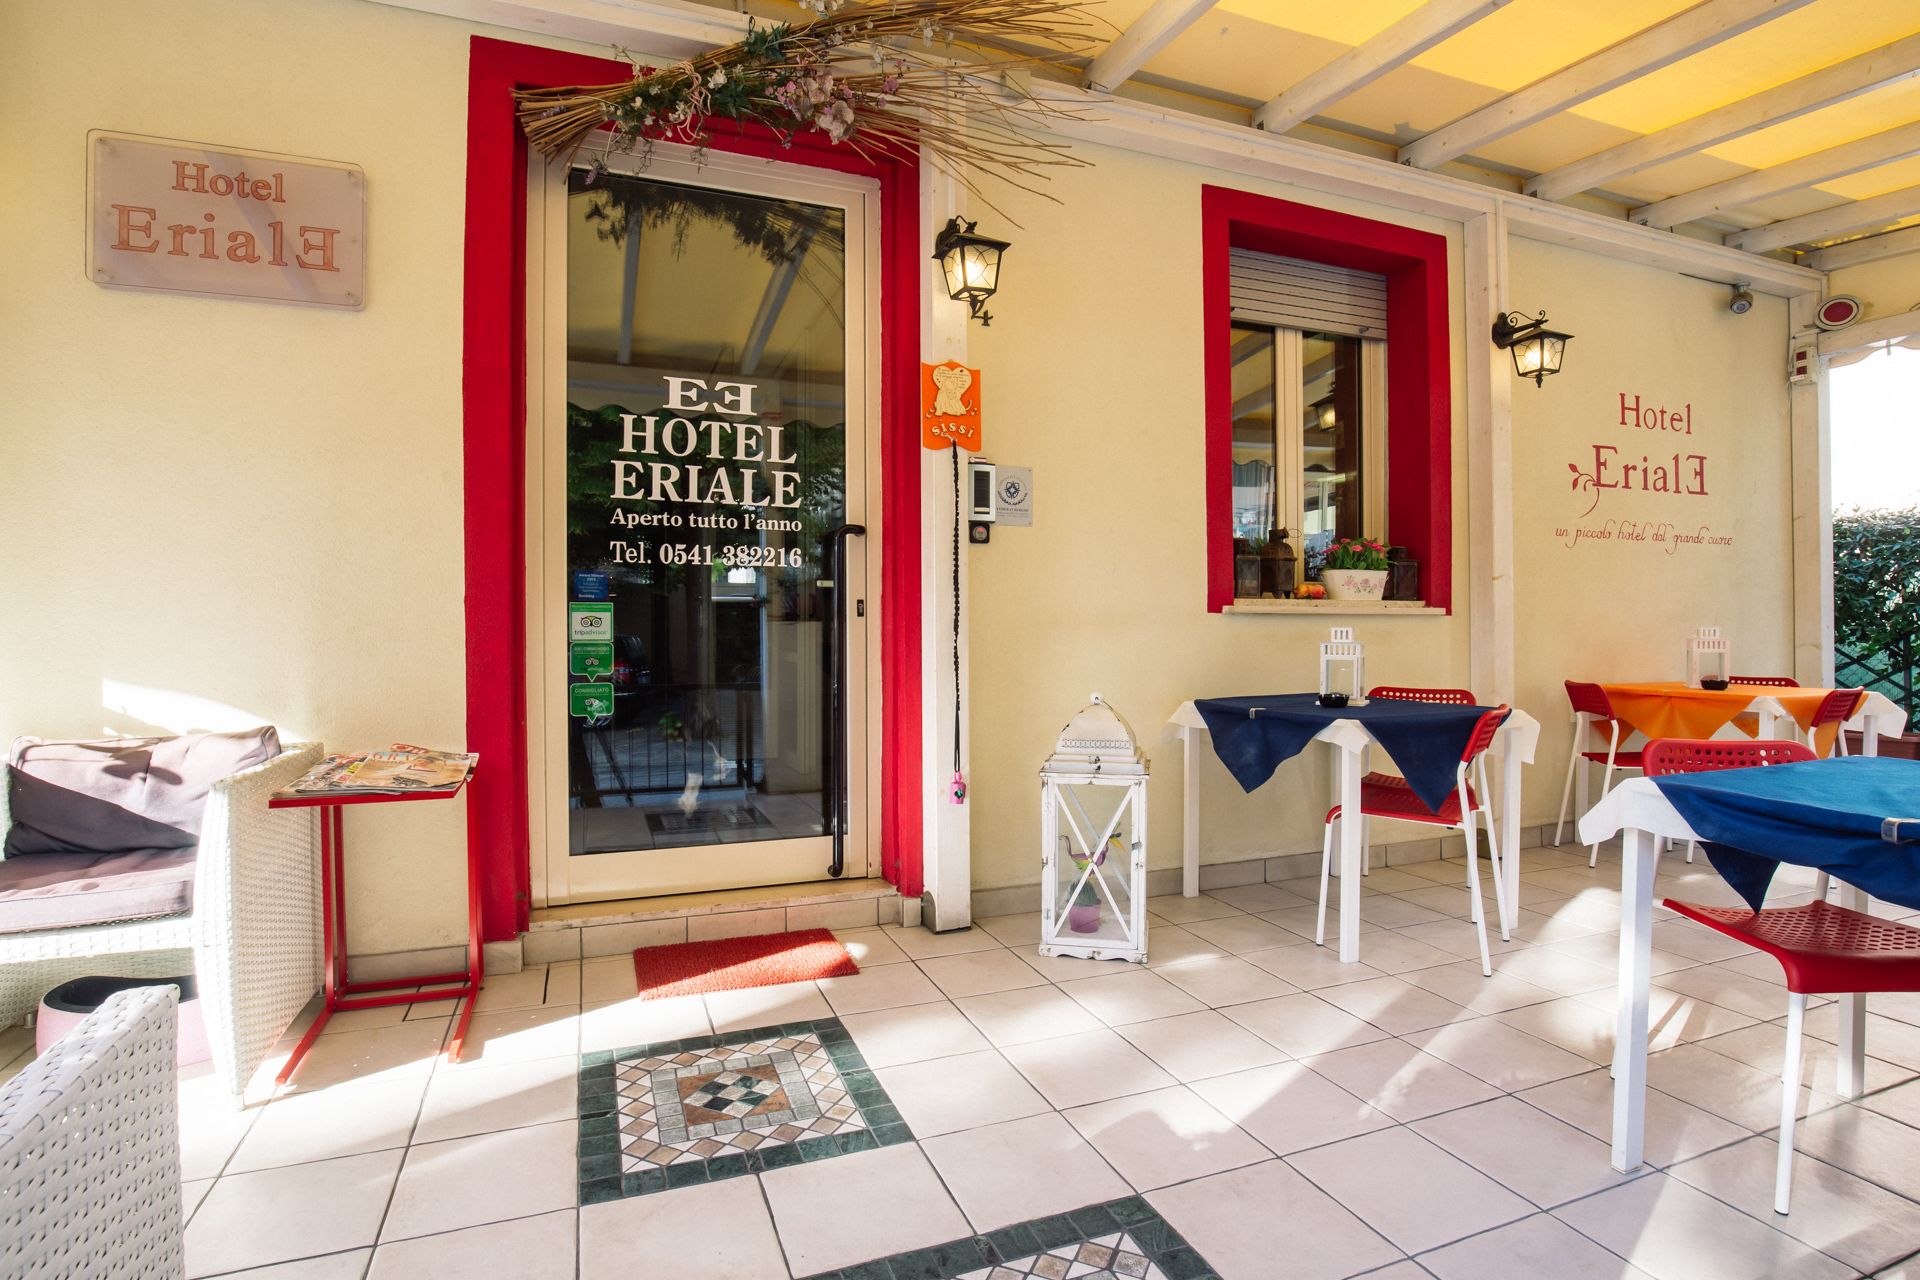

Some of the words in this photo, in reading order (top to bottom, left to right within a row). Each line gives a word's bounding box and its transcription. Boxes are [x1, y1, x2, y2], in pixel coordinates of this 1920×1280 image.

[171, 160, 286, 203] Hotel
[1619, 393, 1692, 435] Hotel
[619, 413, 797, 464] HOTEL
[610, 460, 801, 508] ERIALE
[610, 508, 682, 529] Aperto
[689, 513, 738, 529] tutto
[1555, 527, 1568, 537] un
[1565, 519, 1616, 548] piccolo
[1617, 520, 1653, 541] hotel
[1652, 523, 1674, 542] dal
[1665, 527, 1709, 555] grande
[1708, 536, 1733, 546] cuore
[609, 541, 652, 564] Tel.
[659, 544, 714, 566] 0541
[723, 545, 802, 568] 382216
